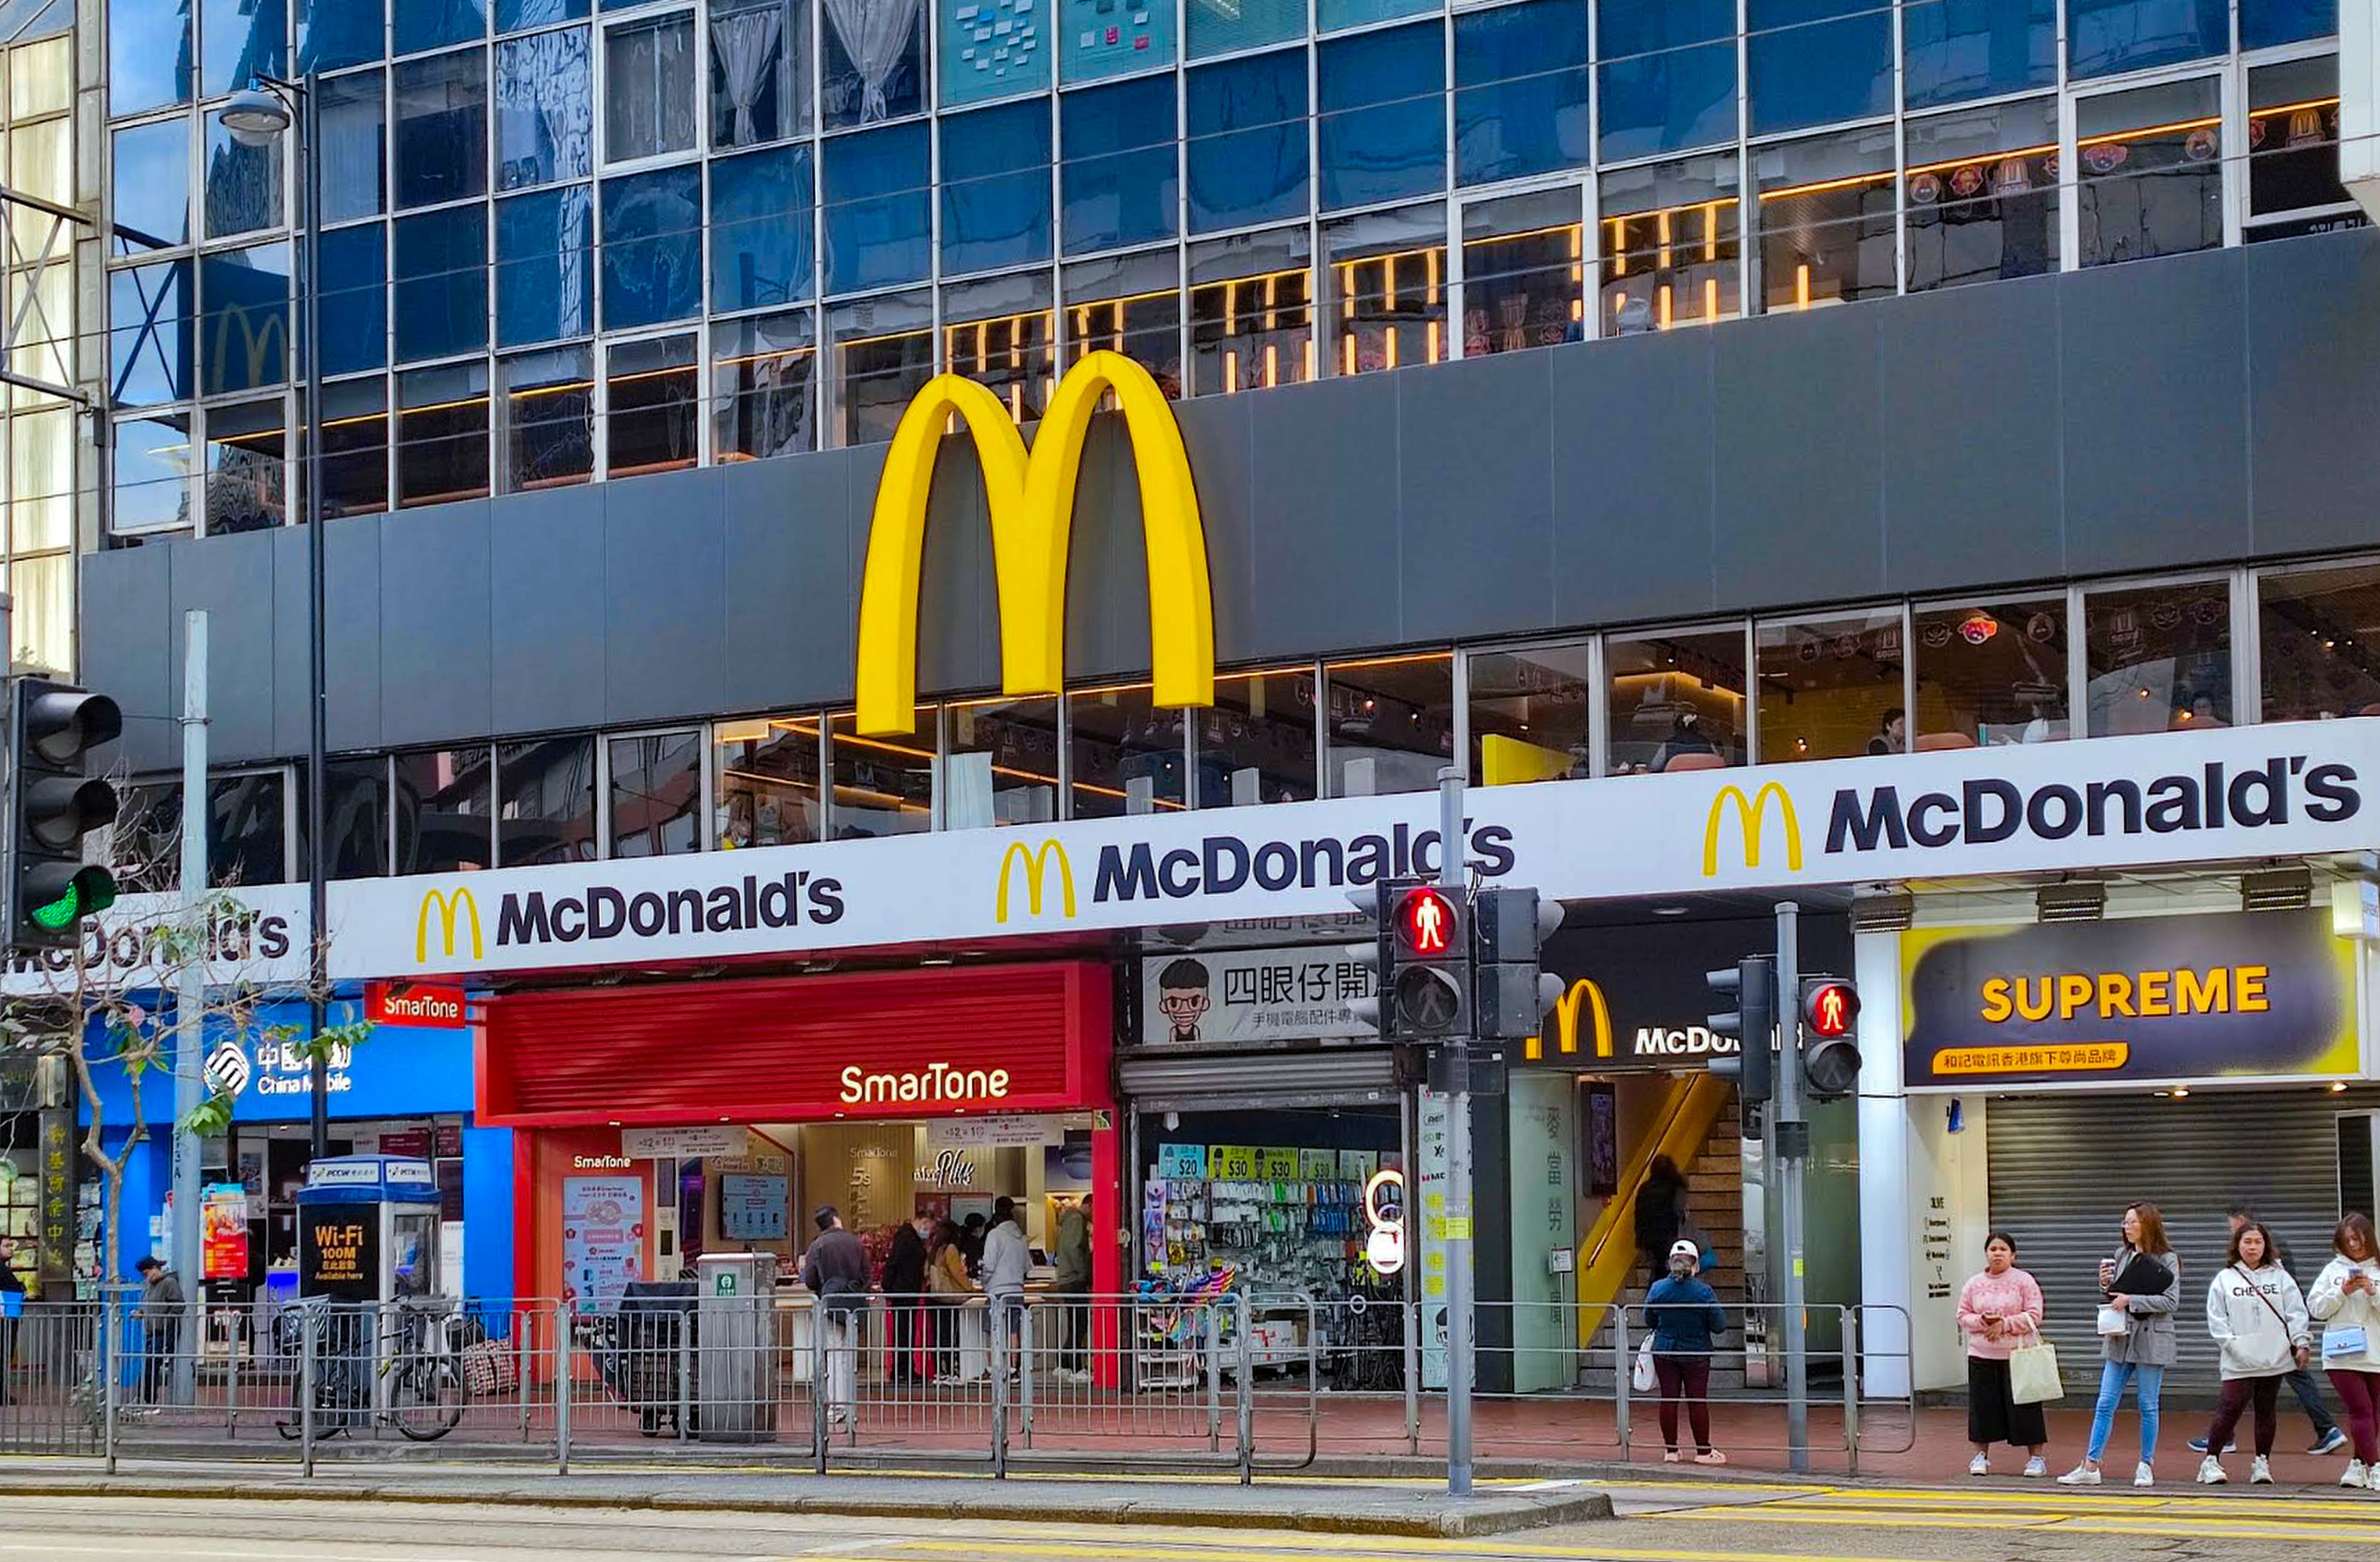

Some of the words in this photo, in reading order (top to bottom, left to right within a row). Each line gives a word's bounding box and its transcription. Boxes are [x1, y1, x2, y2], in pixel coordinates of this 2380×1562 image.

[1825, 756, 2360, 853] McDonald's
[497, 871, 845, 946] McDonald's
[1981, 964, 2269, 1023] SUPREME
[384, 996, 458, 1018] SmarTone
[257, 1076, 300, 1094] China
[302, 1072, 352, 1093] Mbile
[840, 1062, 1009, 1103] SmarTone
[574, 1155, 631, 1168] SmarTone
[1179, 1159, 1198, 1176] $20
[1228, 1160, 1248, 1177] $30
[1271, 1161, 1291, 1177] $30
[315, 1225, 363, 1247] Wi-Fi
[321, 1247, 356, 1259] 100M
